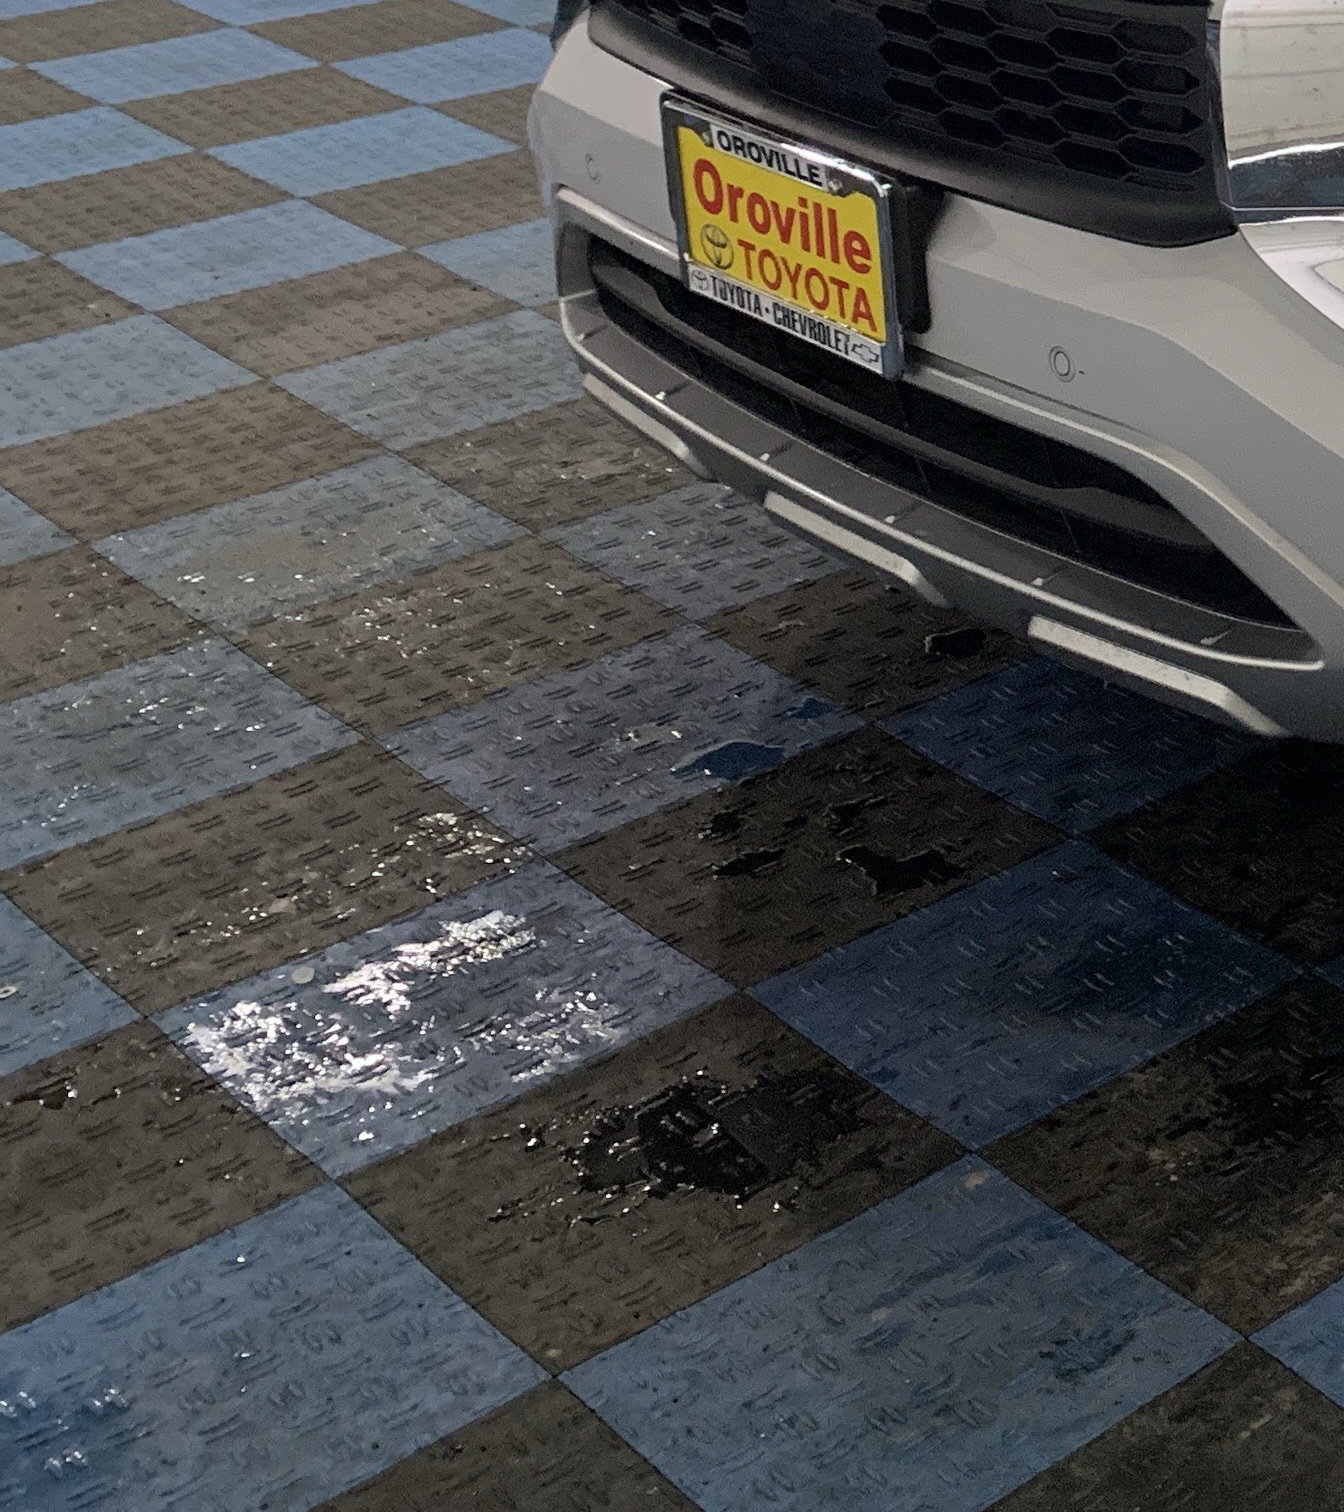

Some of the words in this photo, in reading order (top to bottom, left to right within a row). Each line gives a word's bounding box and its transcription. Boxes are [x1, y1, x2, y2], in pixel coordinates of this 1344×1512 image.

[716, 130, 823, 186] OROVILLE
[694, 158, 872, 274] Oroville
[711, 274, 764, 318] TOYOTA
[773, 301, 851, 356] CHEVROLET
[738, 239, 878, 333] TOYOTA
